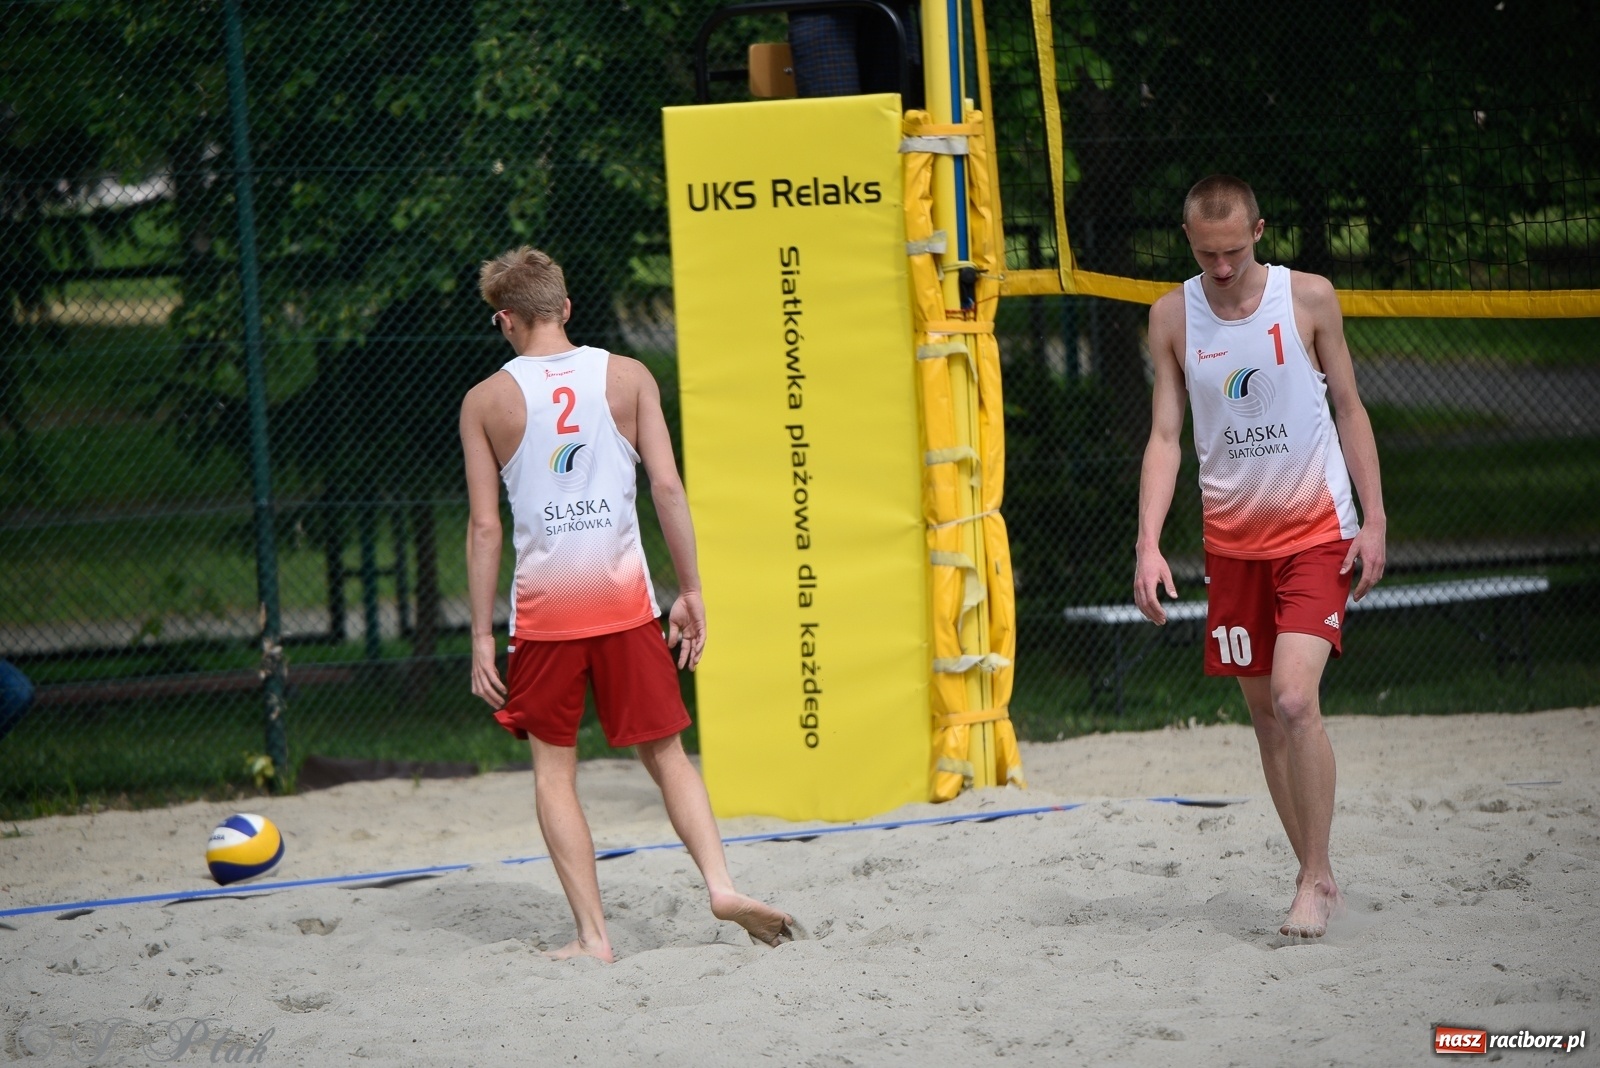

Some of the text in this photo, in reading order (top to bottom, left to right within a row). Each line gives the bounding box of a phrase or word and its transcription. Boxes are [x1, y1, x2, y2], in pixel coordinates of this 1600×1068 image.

[687, 175, 883, 212] UKS Relaks
[1267, 322, 1285, 366] 1
[552, 386, 580, 435] 2
[1223, 423, 1289, 447] ŚLĄSKA
[1228, 442, 1290, 460] SIATKÓWKA
[544, 498, 611, 521] ŚLĄSKA
[780, 245, 823, 749] Siatkówka plażowa dla każdego
[546, 517, 613, 537] SIATKÓWKA
[1211, 625, 1253, 667] 10
